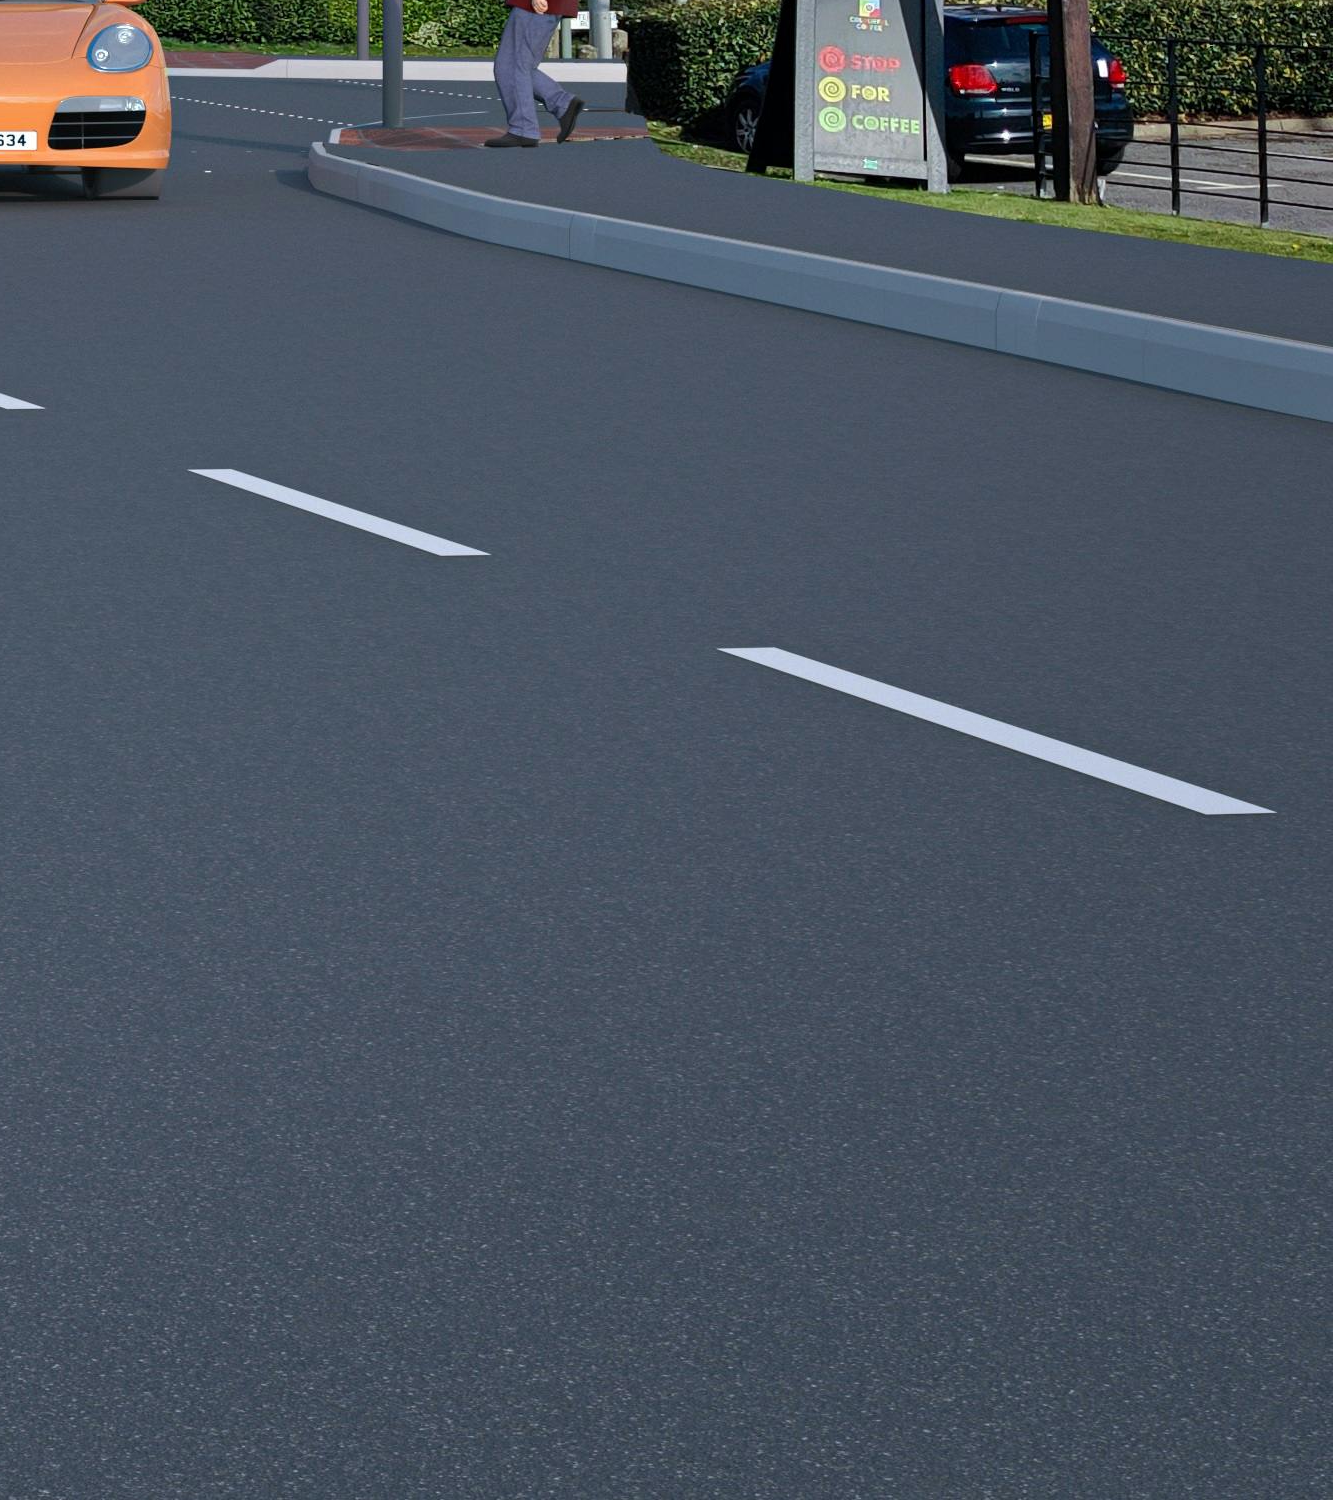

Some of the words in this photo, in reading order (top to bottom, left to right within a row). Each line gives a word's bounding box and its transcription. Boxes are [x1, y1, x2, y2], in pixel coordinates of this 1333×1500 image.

[851, 54, 901, 72] STOP
[851, 84, 890, 102] FOR
[851, 114, 921, 135] COFFEE
